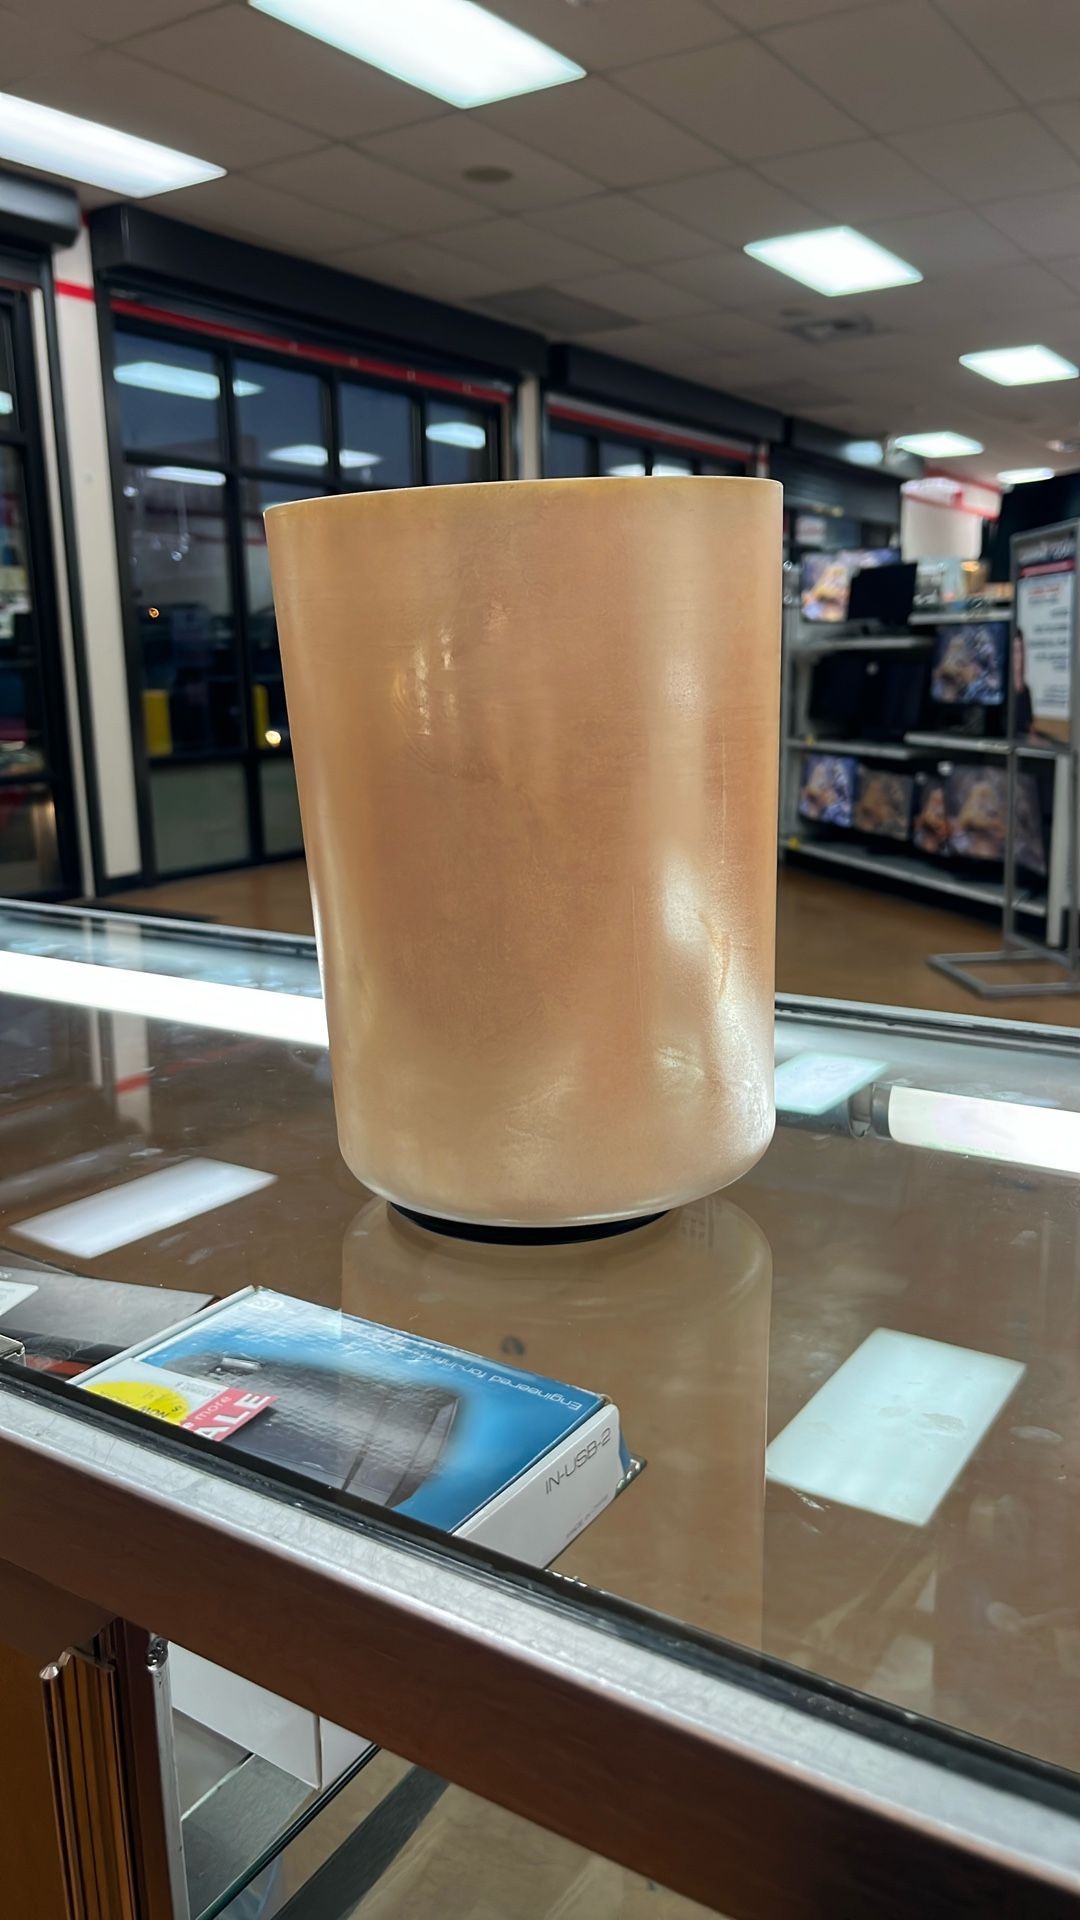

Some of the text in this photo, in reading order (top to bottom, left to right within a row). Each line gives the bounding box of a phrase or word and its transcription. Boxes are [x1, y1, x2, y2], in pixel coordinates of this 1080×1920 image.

[194, 1396, 232, 1420] more
[462, 1364, 583, 1411] Engineered for
[195, 1393, 271, 1440] ALE
[545, 1427, 611, 1494] IN-USB-2
